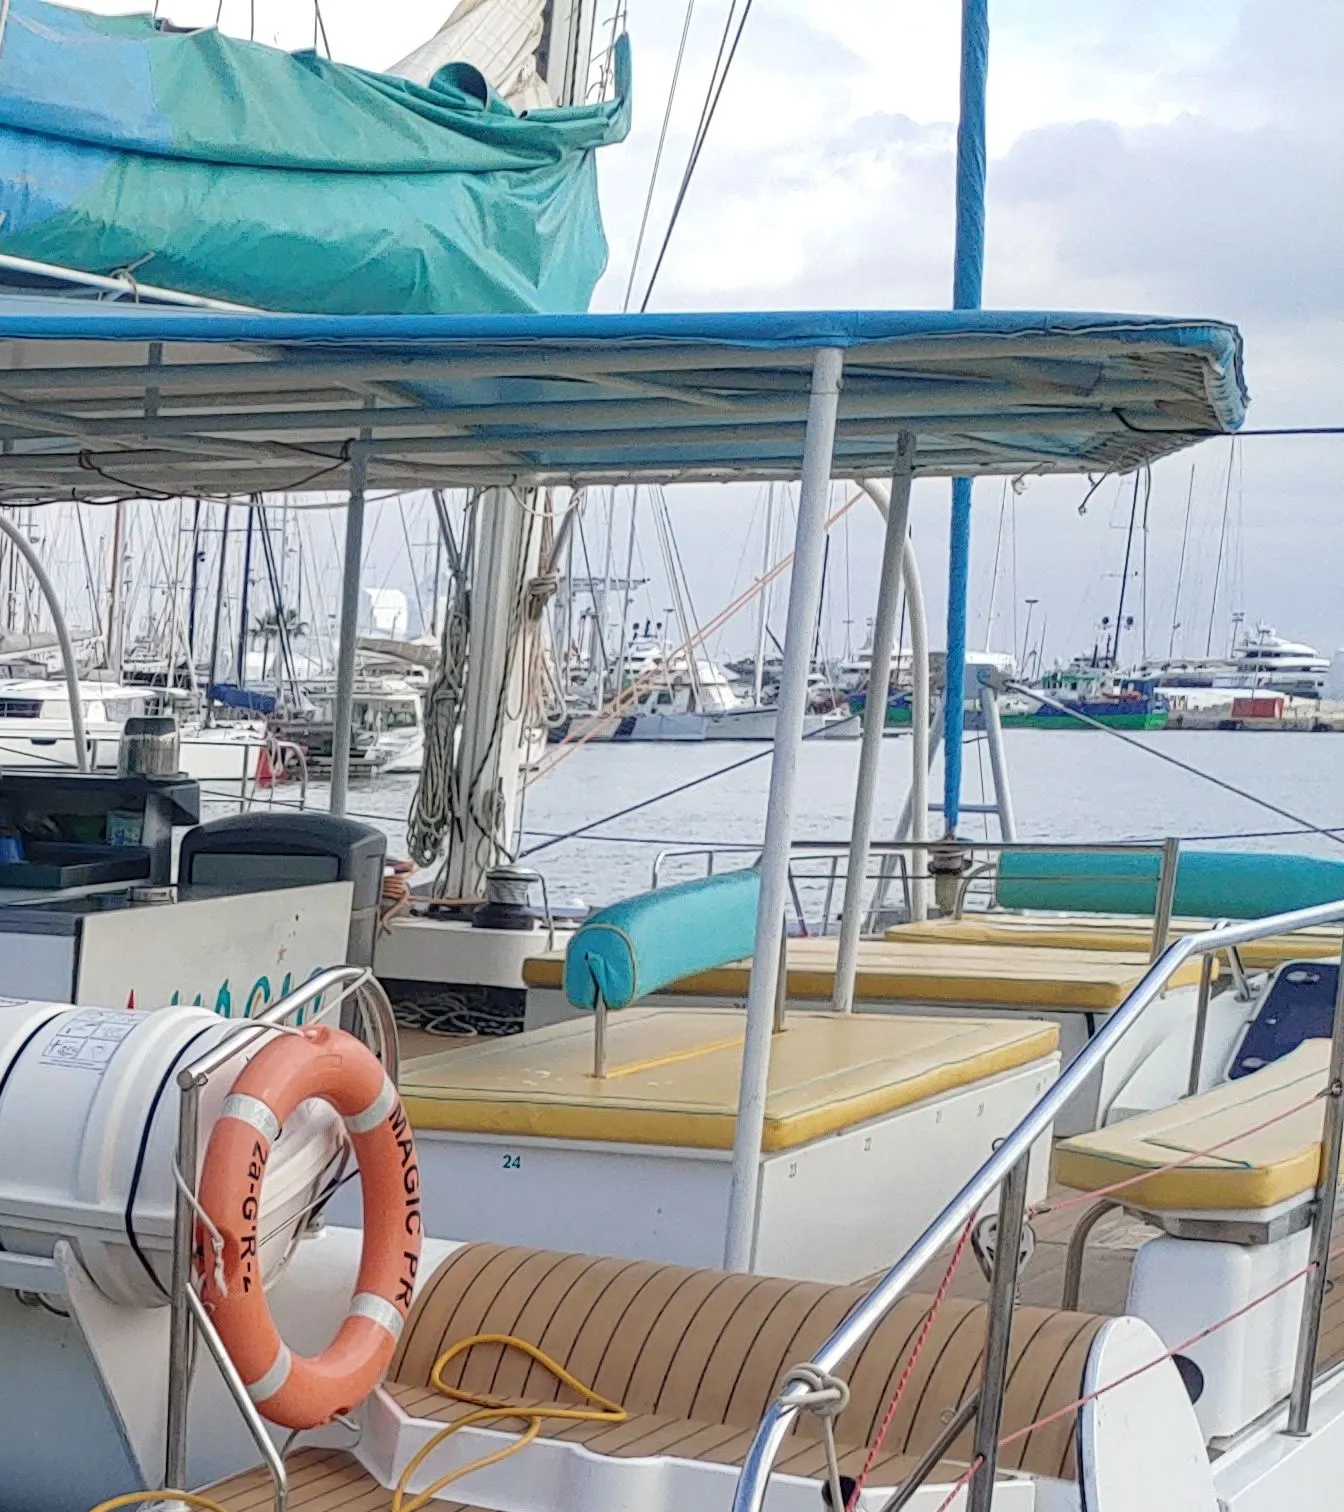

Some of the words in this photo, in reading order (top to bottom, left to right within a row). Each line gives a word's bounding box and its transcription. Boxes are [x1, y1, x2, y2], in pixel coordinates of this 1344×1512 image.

[387, 1103, 422, 1237] MAGIC
[502, 1154, 521, 1169] 24
[394, 1250, 419, 1310] PR
